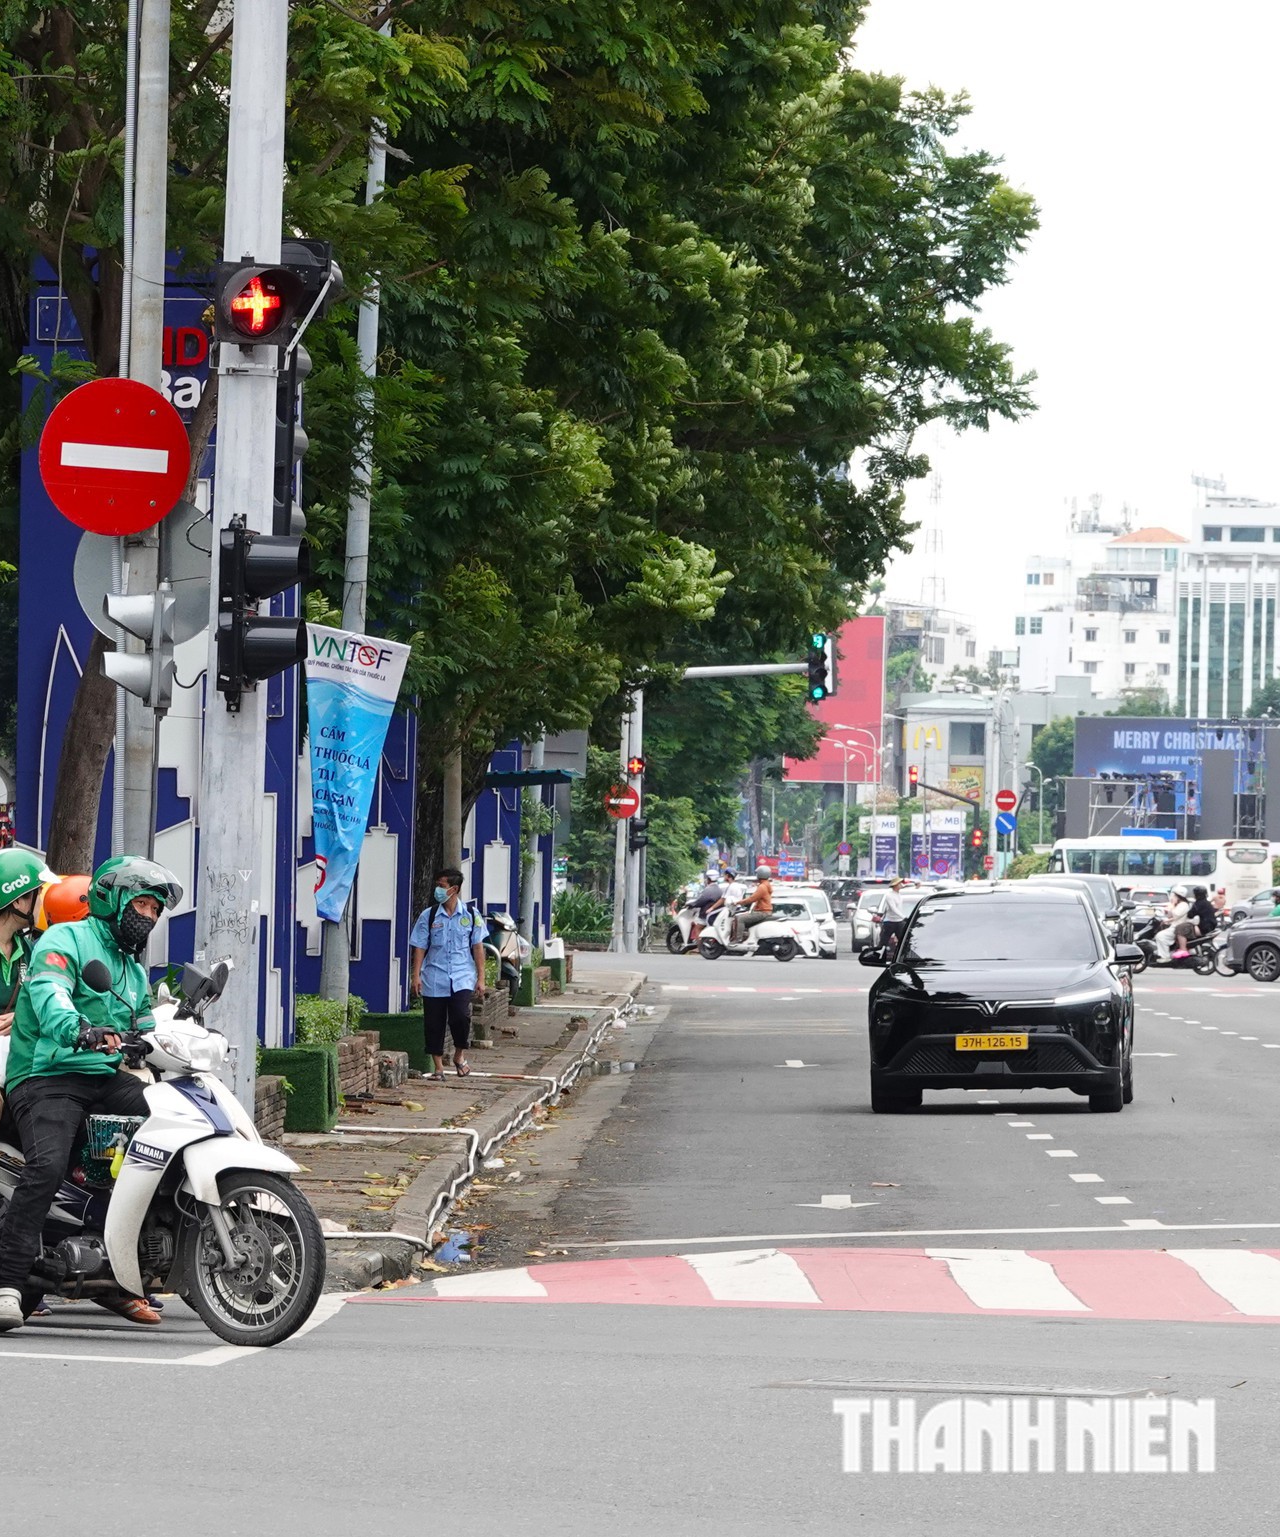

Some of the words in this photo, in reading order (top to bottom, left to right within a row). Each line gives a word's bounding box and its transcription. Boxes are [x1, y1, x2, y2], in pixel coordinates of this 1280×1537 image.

[1113, 731, 1160, 749] MERRY
[1164, 731, 1245, 750] CHRISTMAS
[1141, 755, 1156, 764] AND
[1157, 755, 1180, 765] HAPPY
[881, 821, 896, 829] MB
[944, 817, 960, 826] MB
[1, 874, 31, 894] Grab
[962, 1037, 1022, 1048] 37H-126.15
[135, 1142, 165, 1161] YAMAHA
